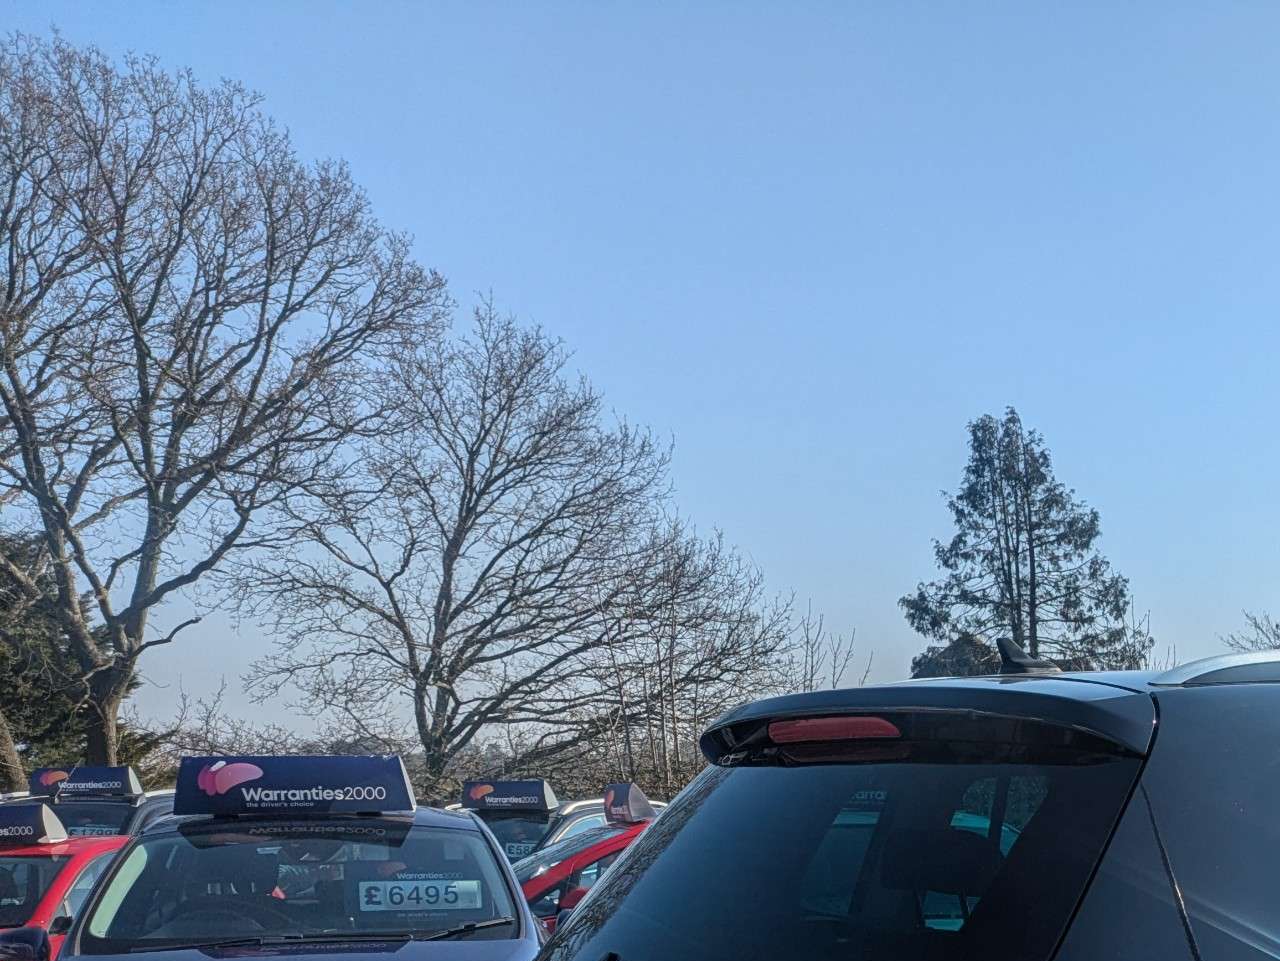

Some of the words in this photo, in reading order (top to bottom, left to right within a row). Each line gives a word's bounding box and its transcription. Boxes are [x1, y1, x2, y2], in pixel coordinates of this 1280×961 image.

[58, 781, 122, 789] Warranties2000
[242, 786, 386, 801] Warranties2000
[485, 796, 538, 804] Warranties2000
